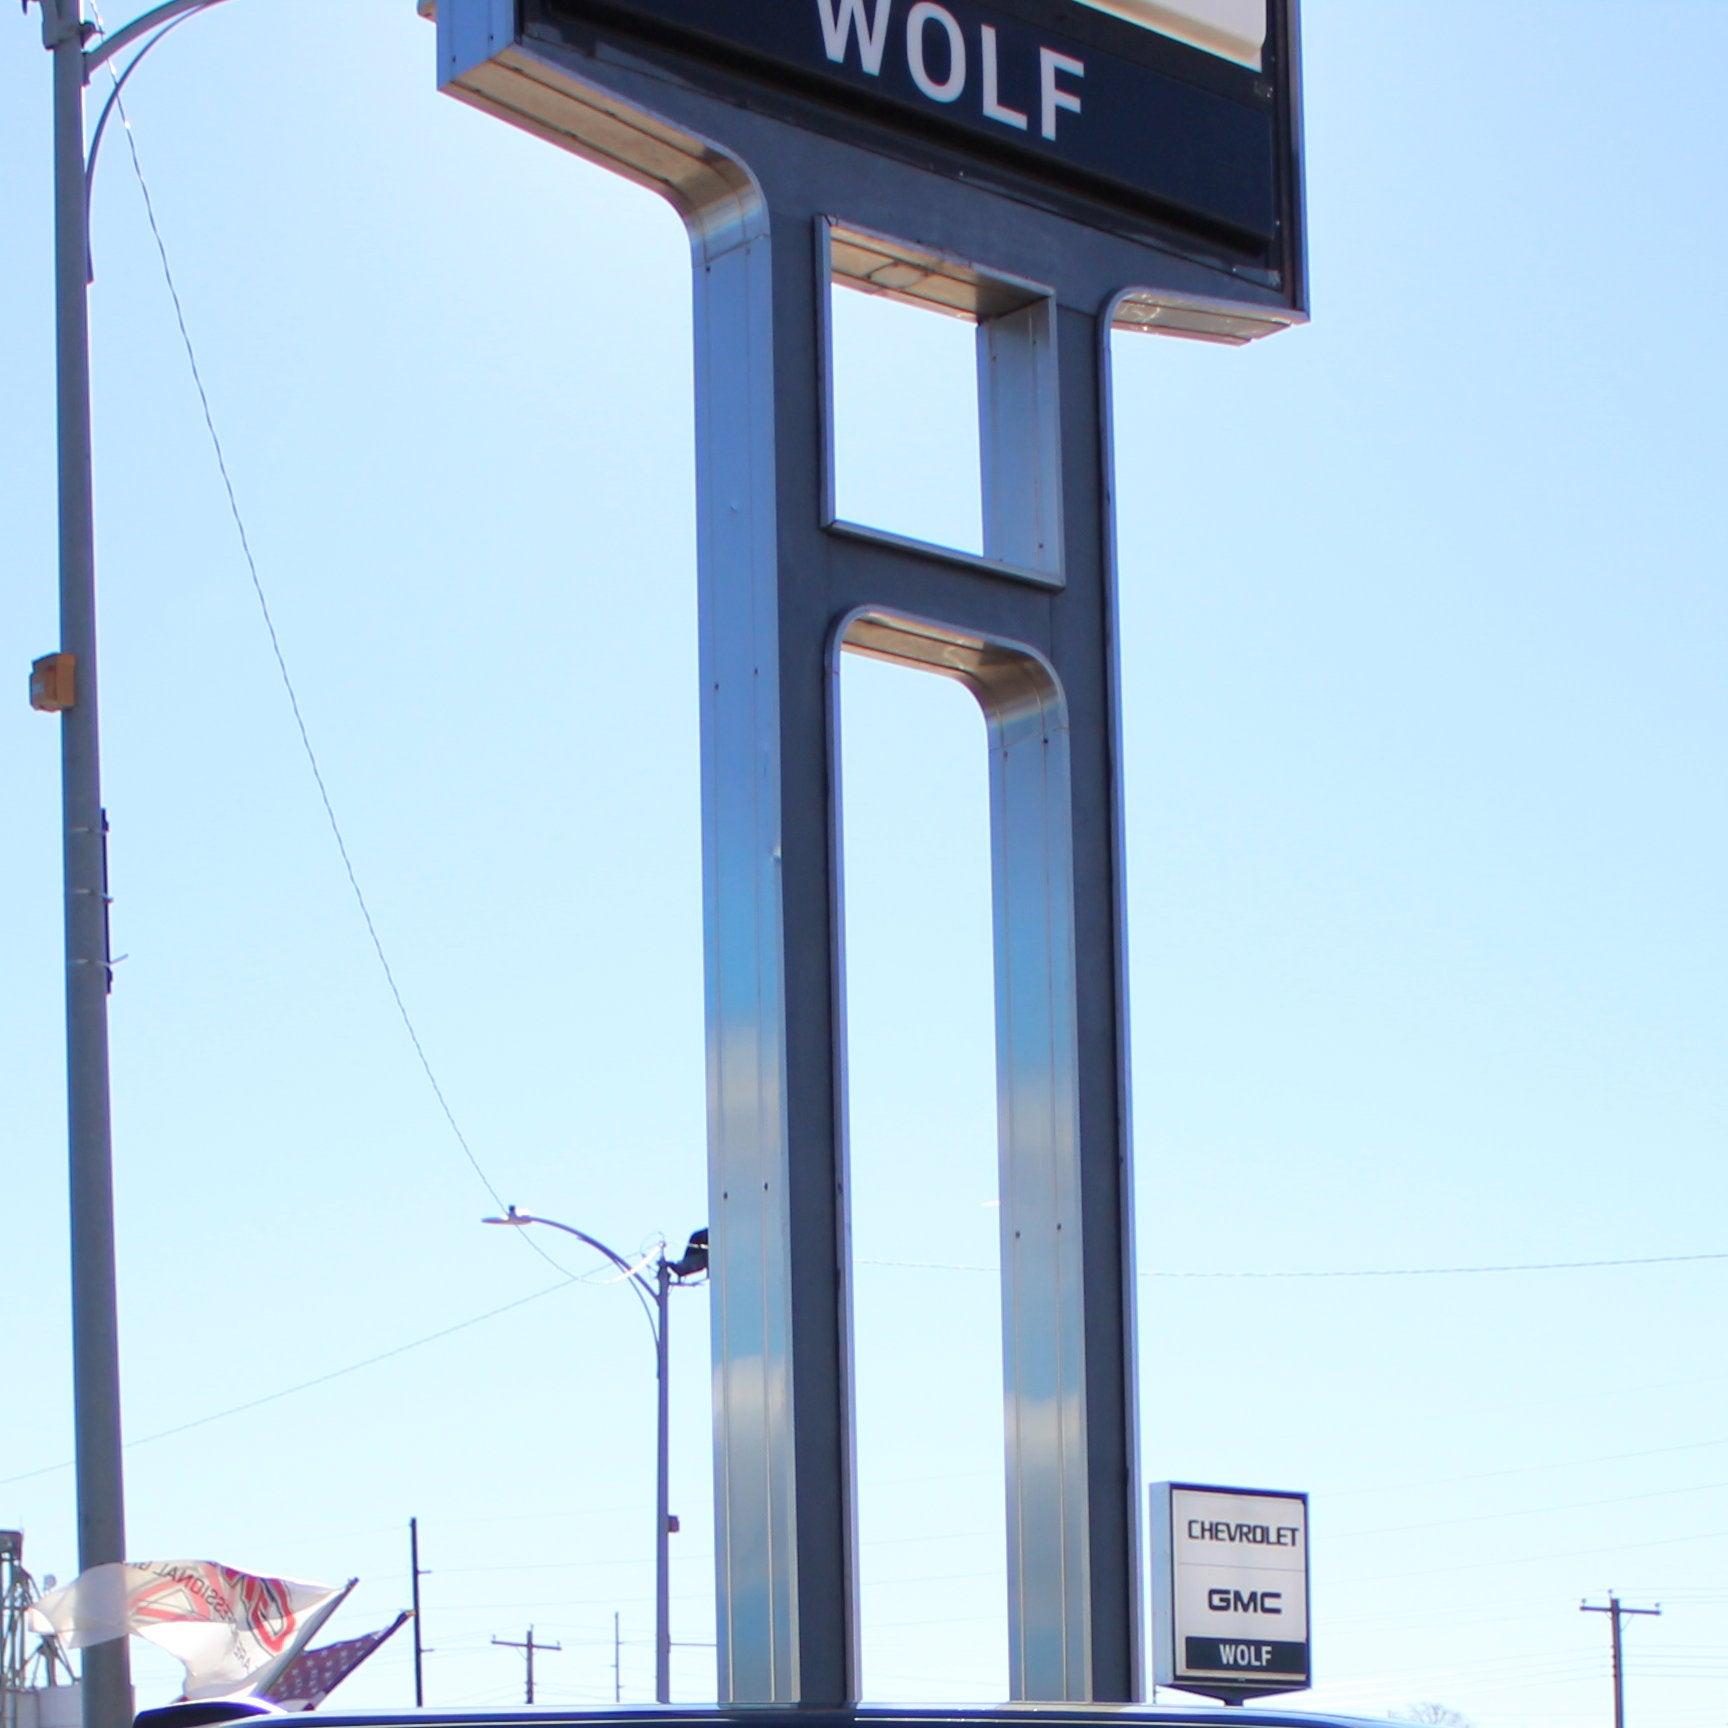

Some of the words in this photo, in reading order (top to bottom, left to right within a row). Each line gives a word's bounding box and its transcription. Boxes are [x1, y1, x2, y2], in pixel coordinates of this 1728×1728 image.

[815, 0, 1085, 143] WOLF
[1188, 1519, 1300, 1547] CHEVROLET
[1207, 1588, 1283, 1615] GMC
[1218, 1643, 1273, 1667] WOLF
